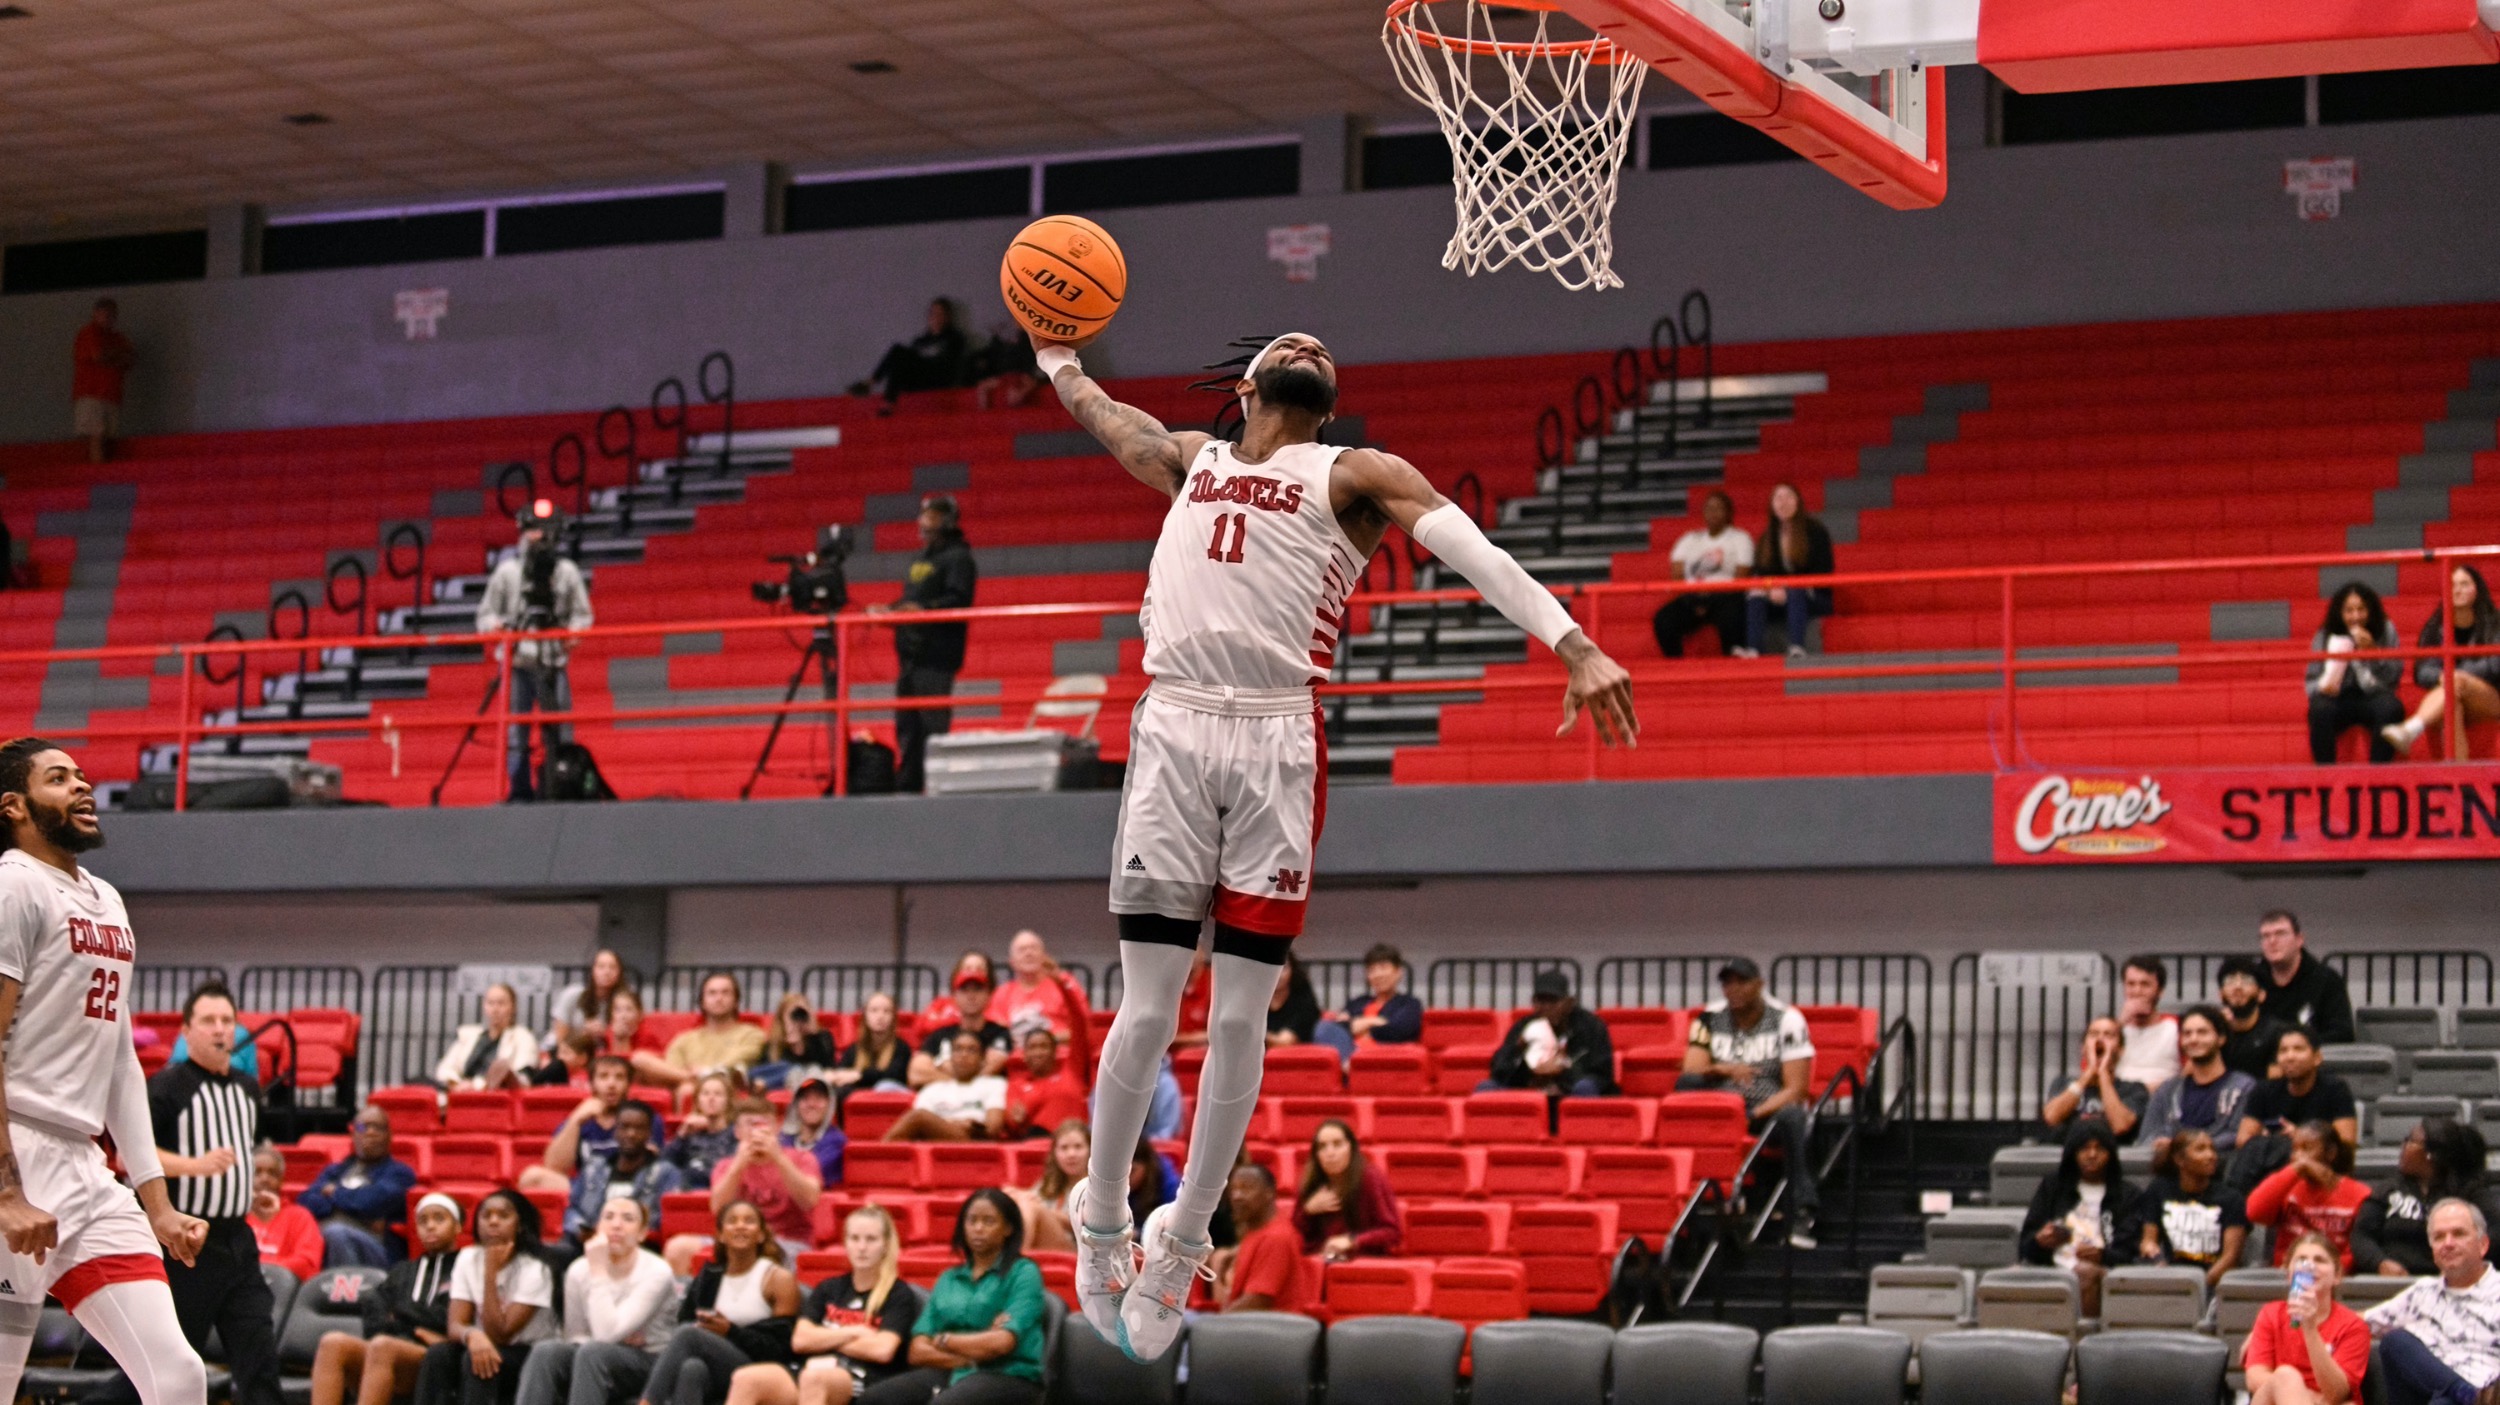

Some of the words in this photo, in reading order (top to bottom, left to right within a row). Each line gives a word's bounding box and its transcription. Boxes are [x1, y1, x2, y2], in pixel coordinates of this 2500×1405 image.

[1007, 284, 1078, 336] Wilson
[1033, 269, 1083, 302] EVO
[1207, 512, 1247, 564] 11
[2014, 775, 2172, 855] Cane's
[2221, 783, 2500, 842] STUDEN
[1275, 868, 1303, 894] N
[84, 967, 120, 1022] 22
